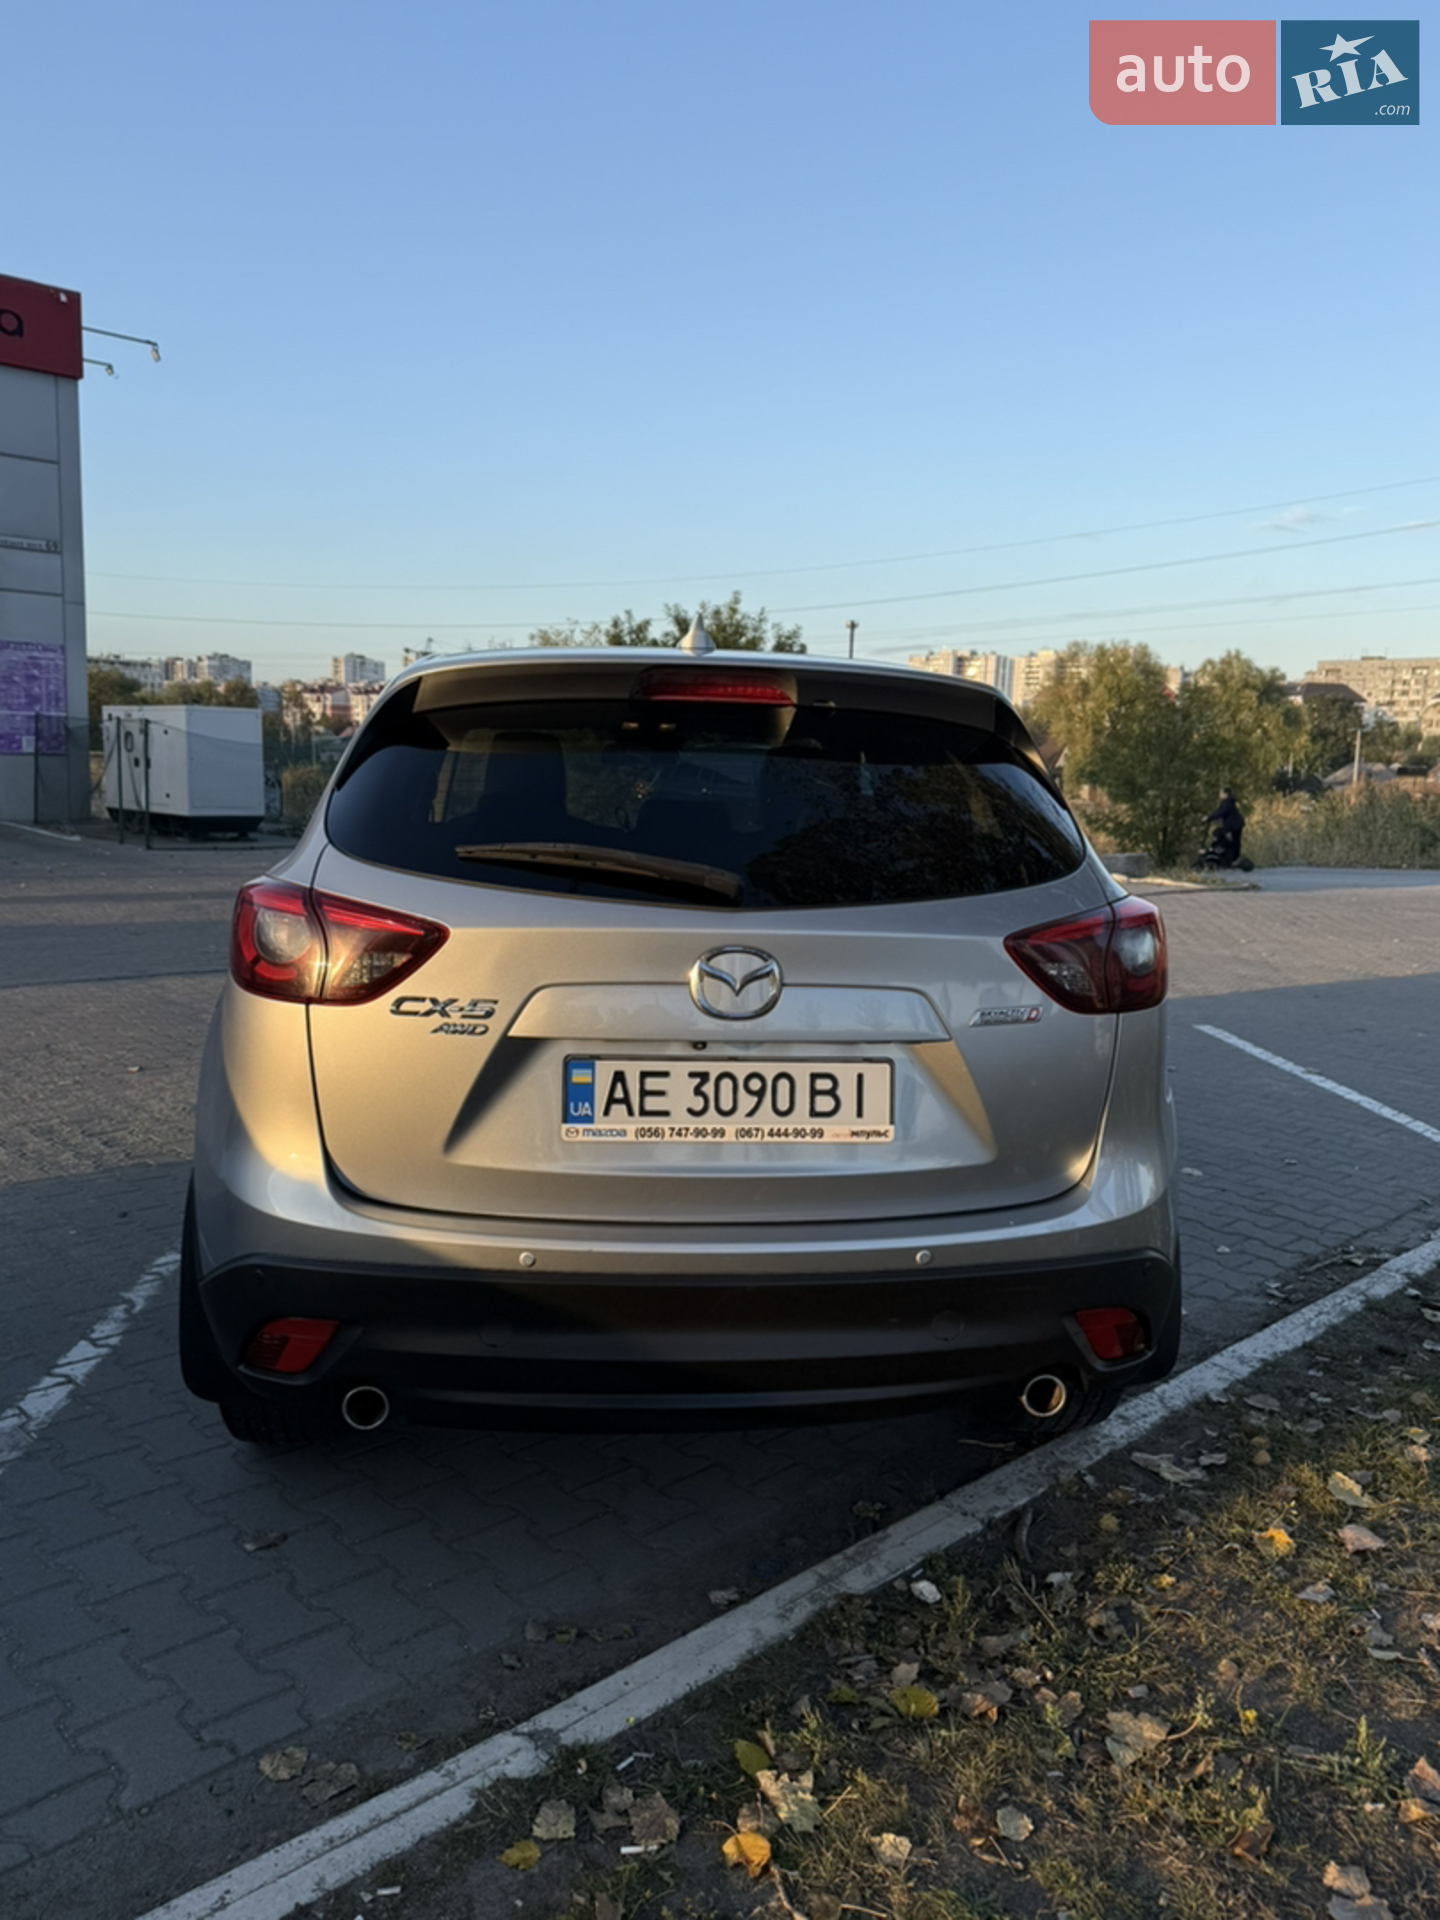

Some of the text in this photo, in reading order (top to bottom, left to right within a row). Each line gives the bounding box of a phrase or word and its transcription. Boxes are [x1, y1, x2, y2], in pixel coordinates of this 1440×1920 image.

[390, 995, 499, 1020] CX-5
[430, 1022, 489, 1036] AWD
[603, 1070, 864, 1118] AE 3090 BI
[570, 1101, 592, 1117] UA
[582, 1129, 627, 1138] mazda
[634, 1126, 666, 1140] (056)
[668, 1127, 726, 1139] 747-90-99
[735, 1127, 765, 1140] (067)
[767, 1127, 824, 1139] 444-90-99
